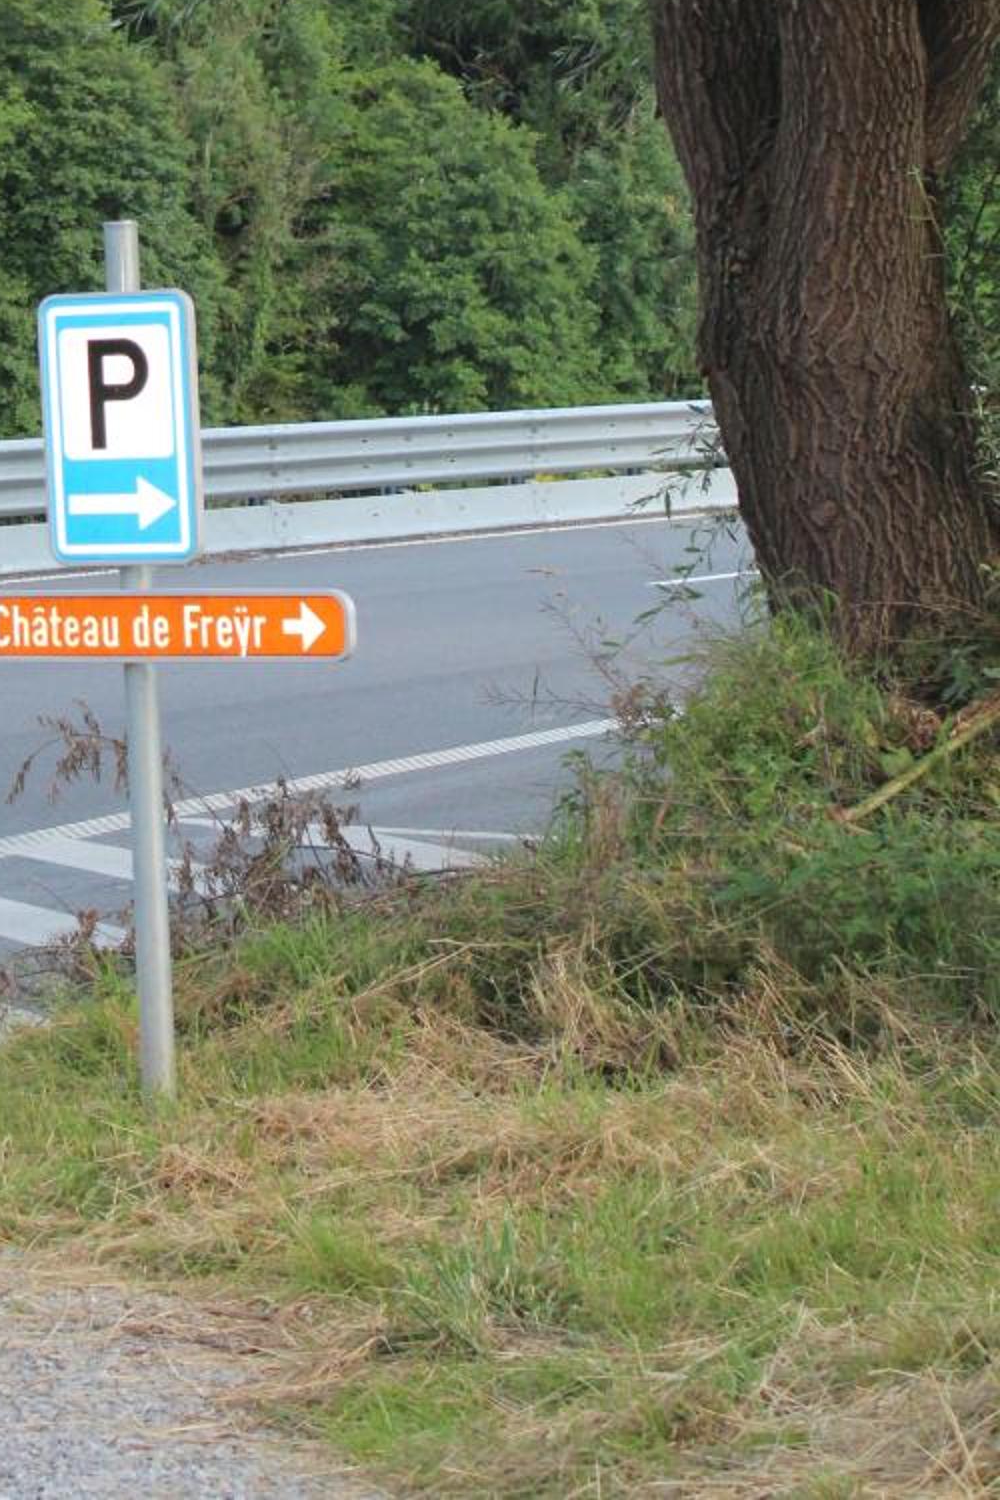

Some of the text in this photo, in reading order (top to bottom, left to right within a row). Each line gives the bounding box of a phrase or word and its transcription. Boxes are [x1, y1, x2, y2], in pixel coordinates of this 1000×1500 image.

[87, 338, 149, 450] P
[132, 605, 169, 649] de
[183, 605, 267, 657] Freÿr
